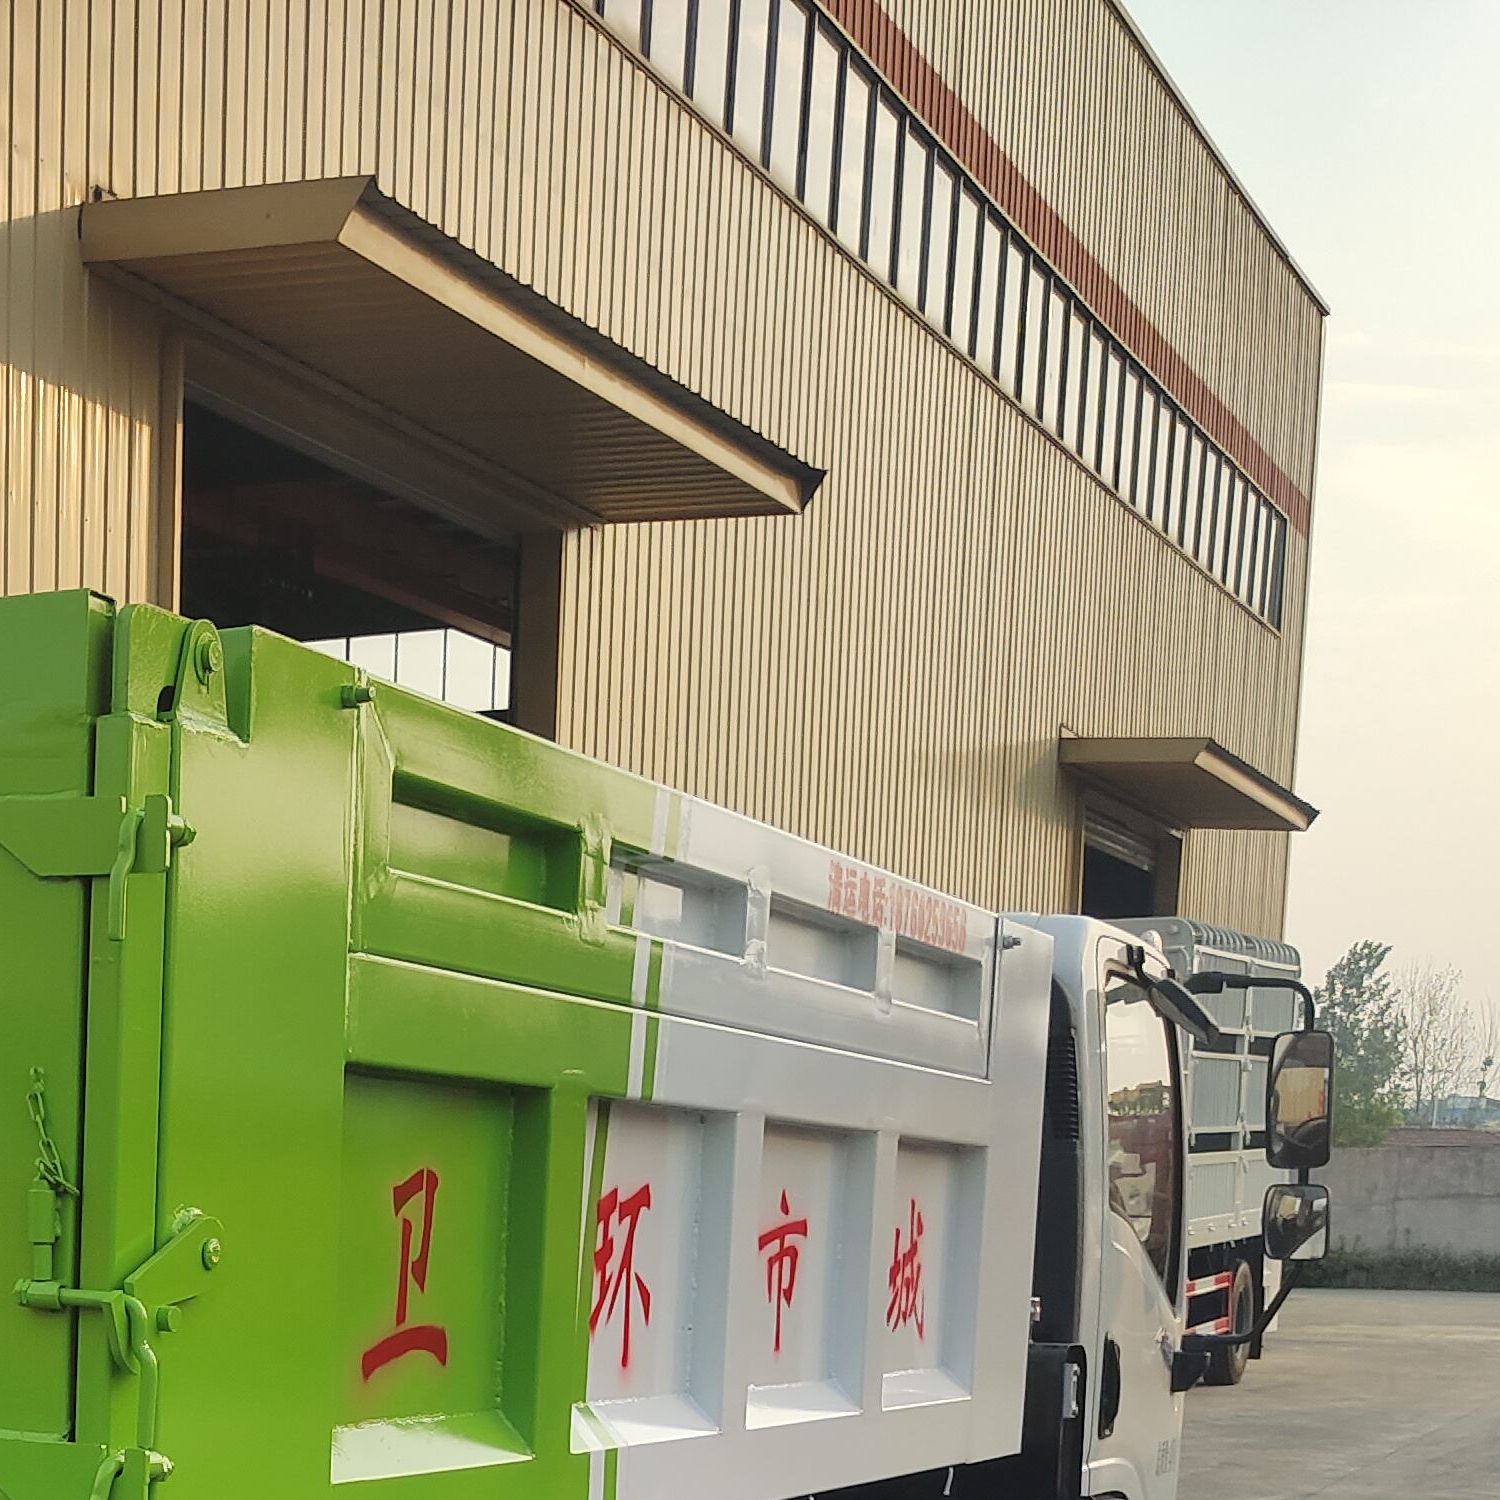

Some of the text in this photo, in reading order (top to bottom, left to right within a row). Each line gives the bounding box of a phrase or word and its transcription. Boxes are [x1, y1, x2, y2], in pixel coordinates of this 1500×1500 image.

[361, 1168, 925, 1382] 城 市 环 卫
